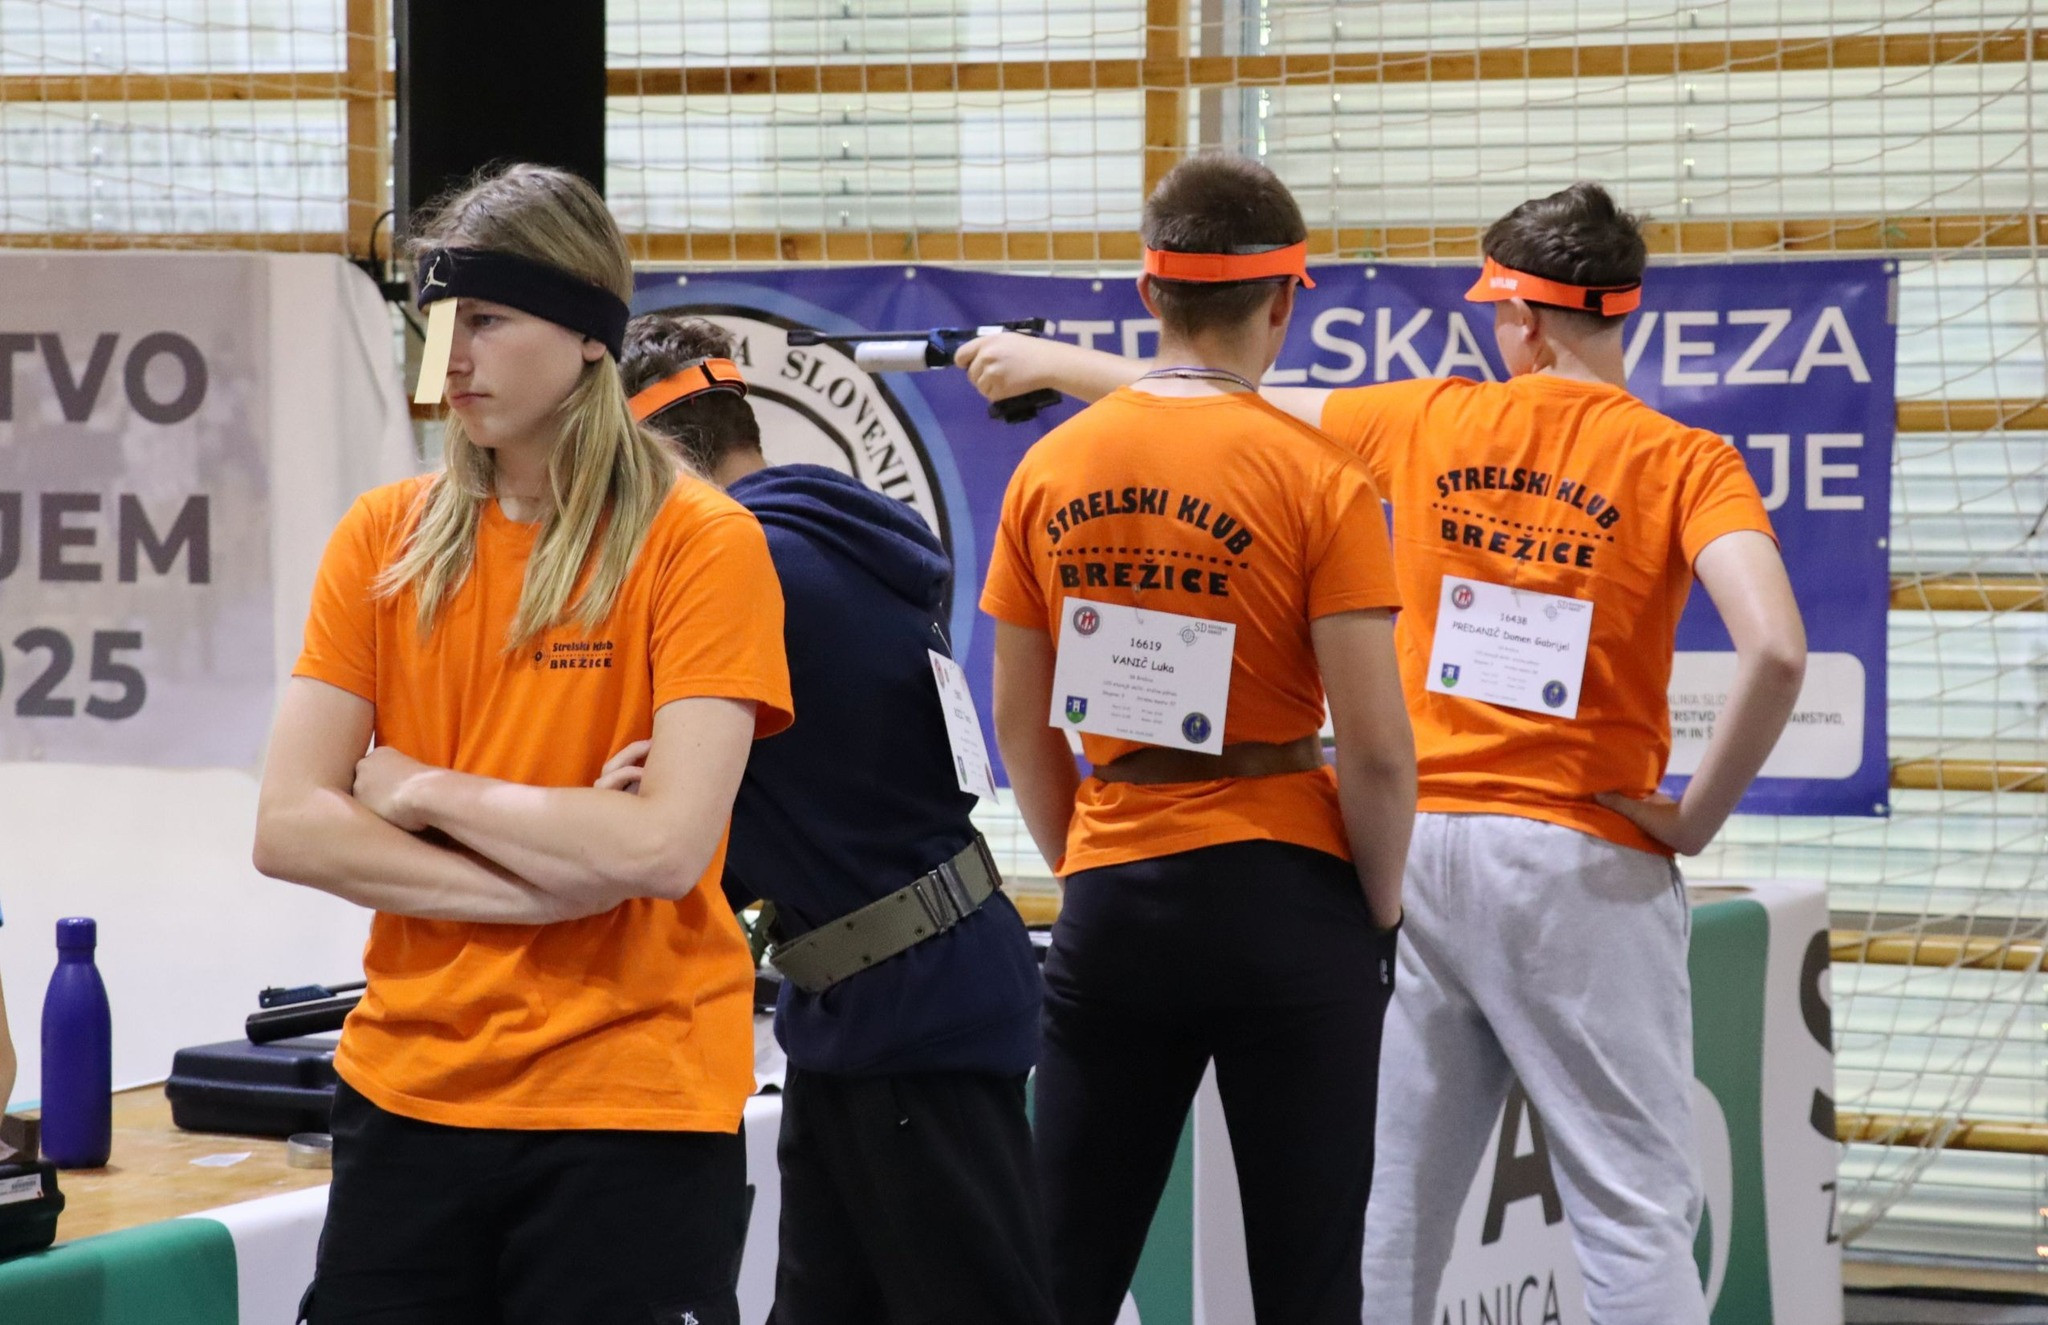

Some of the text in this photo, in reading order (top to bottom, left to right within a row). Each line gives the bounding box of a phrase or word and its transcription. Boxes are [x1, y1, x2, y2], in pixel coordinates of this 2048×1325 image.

[1437, 466, 1620, 529] STRELSKI KLUB
[1047, 487, 1253, 555] STRELSKI KLUB
[1441, 518, 1595, 568] BREŽICE
[1060, 558, 1229, 596] BREŽICE
[1130, 637, 1162, 652] 16619
[1503, 630, 1532, 644] Domen
[1535, 636, 1570, 652] Gabrijel
[1151, 660, 1175, 674] Luka
